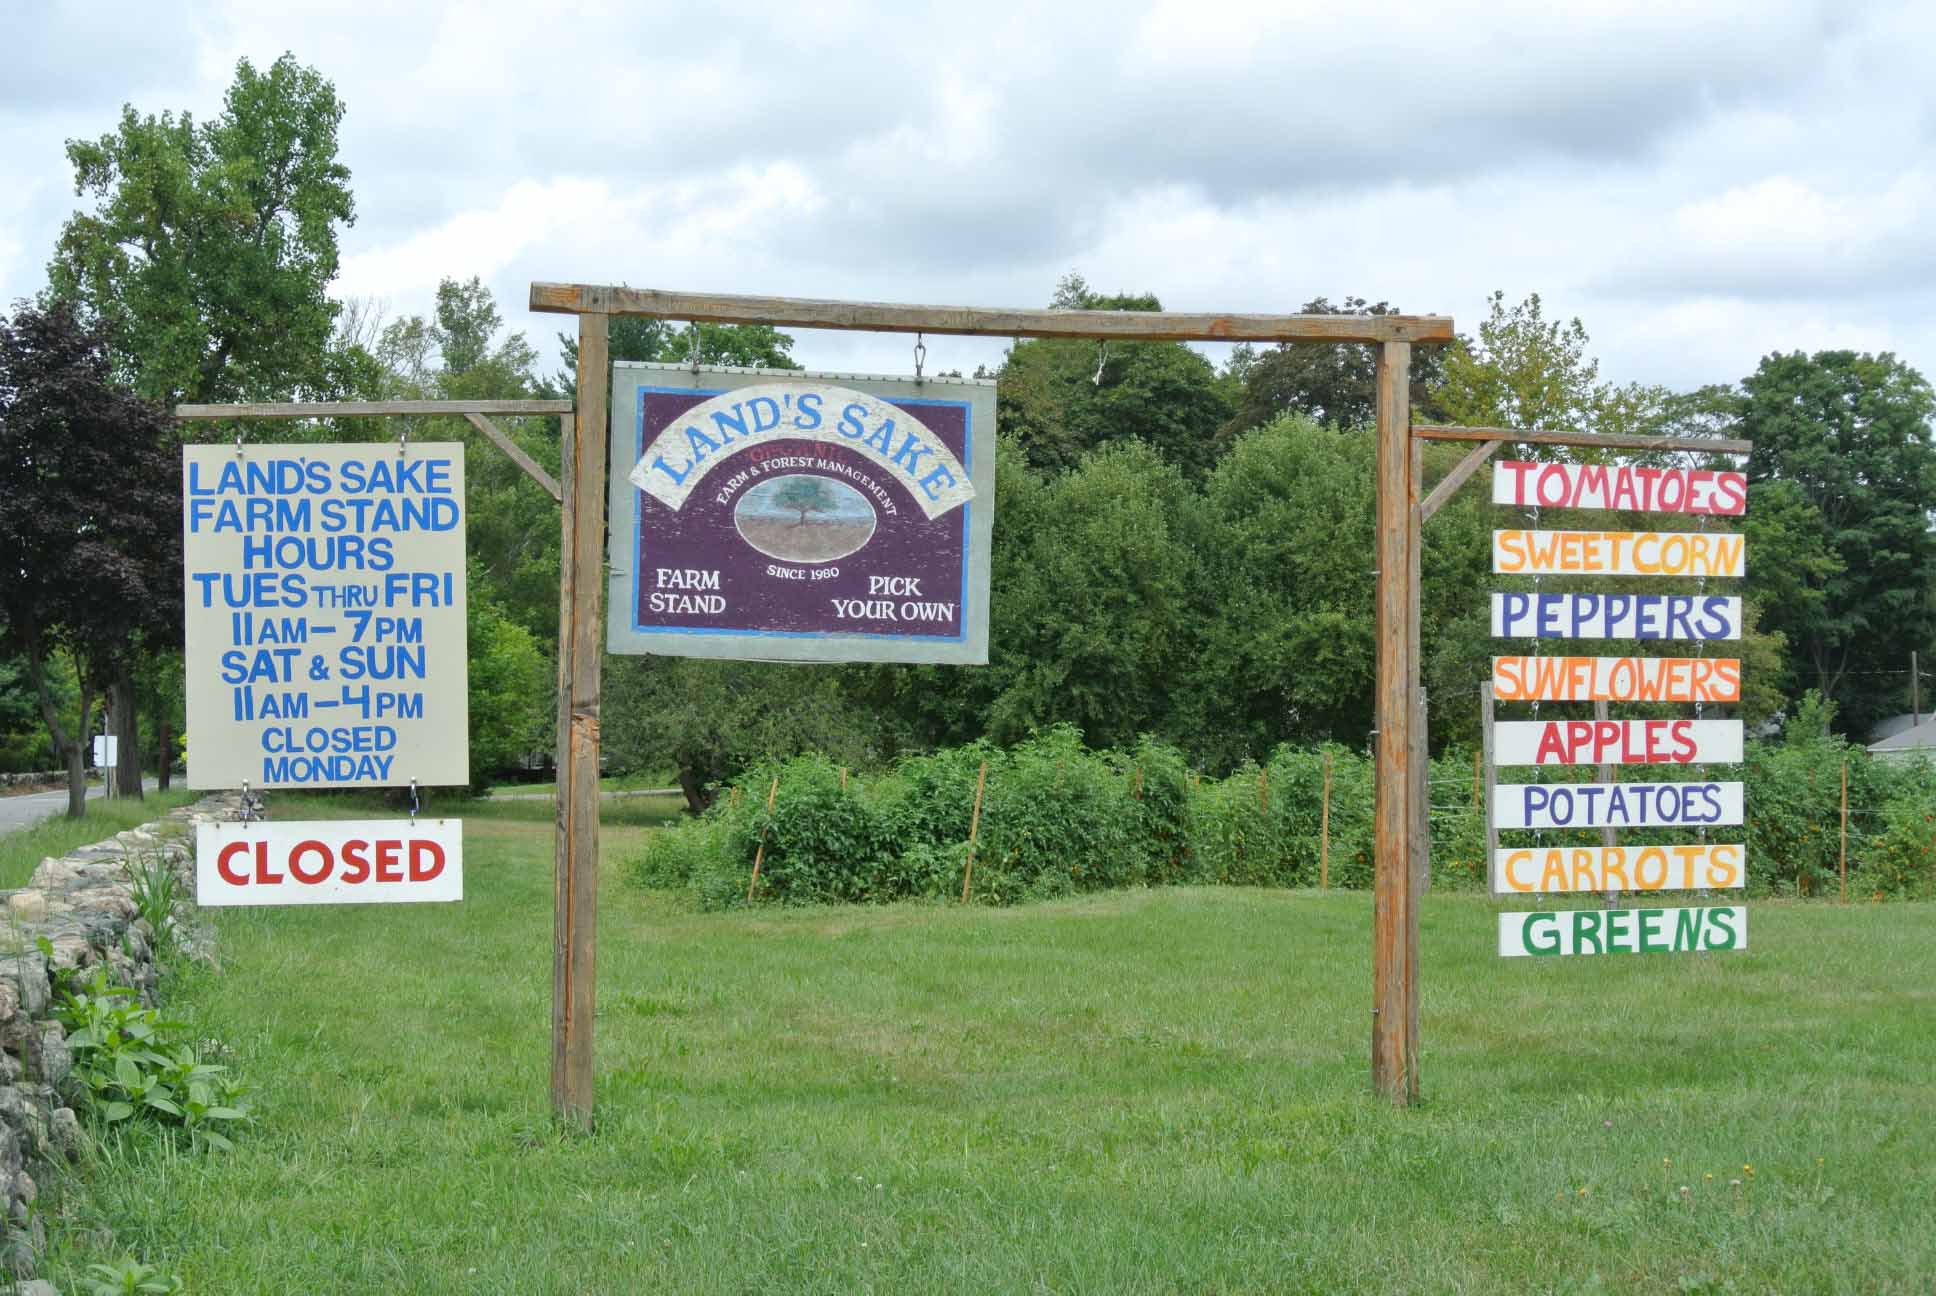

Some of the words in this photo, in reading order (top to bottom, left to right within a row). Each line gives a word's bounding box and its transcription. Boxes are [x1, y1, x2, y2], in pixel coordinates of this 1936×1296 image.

[653, 393, 823, 486] LAND'S
[838, 404, 956, 501] SAKE
[190, 458, 331, 496] LAND'S
[340, 460, 451, 494] SAKE
[716, 471, 750, 506] FARM
[749, 464, 761, 478] &
[760, 456, 815, 473] FOREST
[816, 457, 898, 517] MANAGEMENT
[1503, 461, 1747, 515] TOMATOES
[191, 498, 310, 533] FARM
[321, 497, 459, 532] STAND
[244, 535, 394, 571] HOURS
[767, 561, 806, 579] SINCE
[811, 568, 839, 579] 1980
[192, 573, 307, 608] TUES
[312, 585, 378, 609] THRU
[385, 573, 452, 607] FRI
[657, 569, 720, 591] FARM
[869, 576, 922, 596] PICK
[650, 593, 726, 613] STAND
[832, 600, 897, 621] YOUR
[901, 602, 954, 621] OWN
[1503, 593, 1729, 640] PEPPERS
[222, 649, 301, 684] SAT
[309, 655, 329, 680] &
[340, 645, 425, 680] SUN
[1495, 656, 1740, 701] SUNFLOWERS
[262, 726, 396, 753] CLOSED
[1537, 721, 1696, 764] APPLES
[264, 755, 393, 783] MONDAY
[1525, 784, 1721, 825] POTATOES
[218, 840, 444, 885] CLOSED
[1505, 846, 1737, 892] CARROTS
[1523, 908, 1735, 956] GREENS
